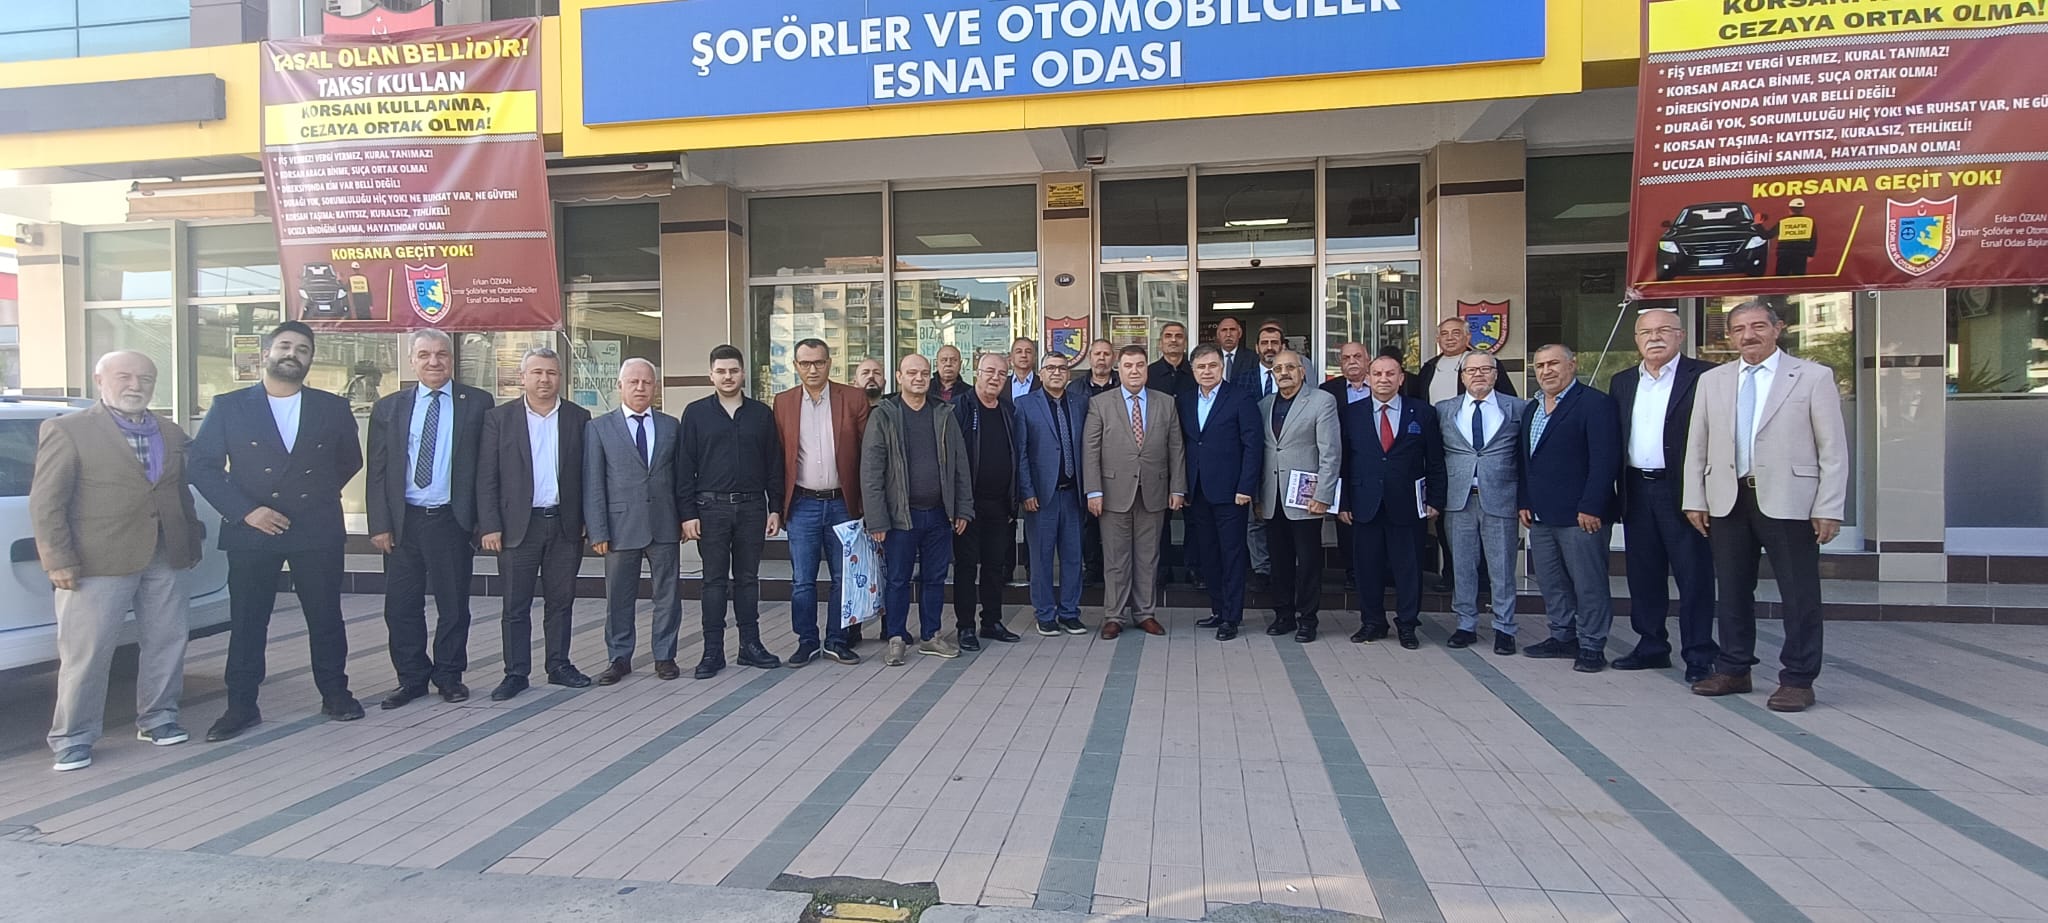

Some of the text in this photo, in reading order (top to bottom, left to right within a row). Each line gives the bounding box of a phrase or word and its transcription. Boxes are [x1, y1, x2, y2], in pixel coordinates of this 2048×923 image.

[1718, 0, 2046, 40] CEZAYA ORTAK OLMA!
[271, 35, 529, 72] YASAL OLAN BELLİDİR!
[691, 14, 911, 76] ŞOFÖRLER
[923, 9, 981, 47] VE
[873, 41, 1182, 99] ESNAF ODASI
[1667, 46, 1950, 80] FİŞ VERMEZ! VERGİ VERMEZ, KURAL TANIMAZ!
[317, 71, 465, 97] TAKSİ KULLAN
[1666, 66, 1938, 97] KORSAN ARACA BİNME, SUÇA ORTAK OLMA!
[302, 98, 491, 119] KORSANI KULLANMA,
[1665, 84, 1896, 116] DİREKSİYONDA KİM VAR BELLİ DEĞİL!
[301, 117, 491, 138] CEZAYA ORTAK OLMA!
[1664, 117, 1713, 134] DURAĞI
[1716, 117, 1746, 129] YOK,
[1749, 107, 1846, 126] SORUMLULUĞU
[1848, 105, 1871, 121] HİÇ
[1873, 106, 1902, 117] YOK!
[1905, 105, 1924, 115] NE
[1926, 101, 1978, 113] RUHSAT
[1980, 99, 2010, 111] VAR,
[2013, 97, 2030, 109] NE
[1663, 118, 1972, 153] KORSAN TAŞIMA: KAYITSIZ, KURALSIZ, TEHLİKELİ!
[364, 150, 389, 159] KURAL
[1662, 140, 1961, 171] UCUZA BİNDİĞİNİ SANMA, HAYATINDAN OLMA!
[351, 166, 370, 176] SUÇA
[371, 165, 399, 174] ORTAK
[399, 164, 428, 174] OLMA!
[1752, 169, 2003, 199] KORSANA GEÇİT YOK!
[340, 181, 354, 190] VAR
[372, 192, 386, 205] HİÇ
[409, 194, 422, 202] NE
[452, 191, 474, 202] VAR,
[475, 191, 486, 200] NE
[418, 222, 446, 231] OLMA!
[331, 243, 474, 261] KORSANA GEÇİT YOK!
